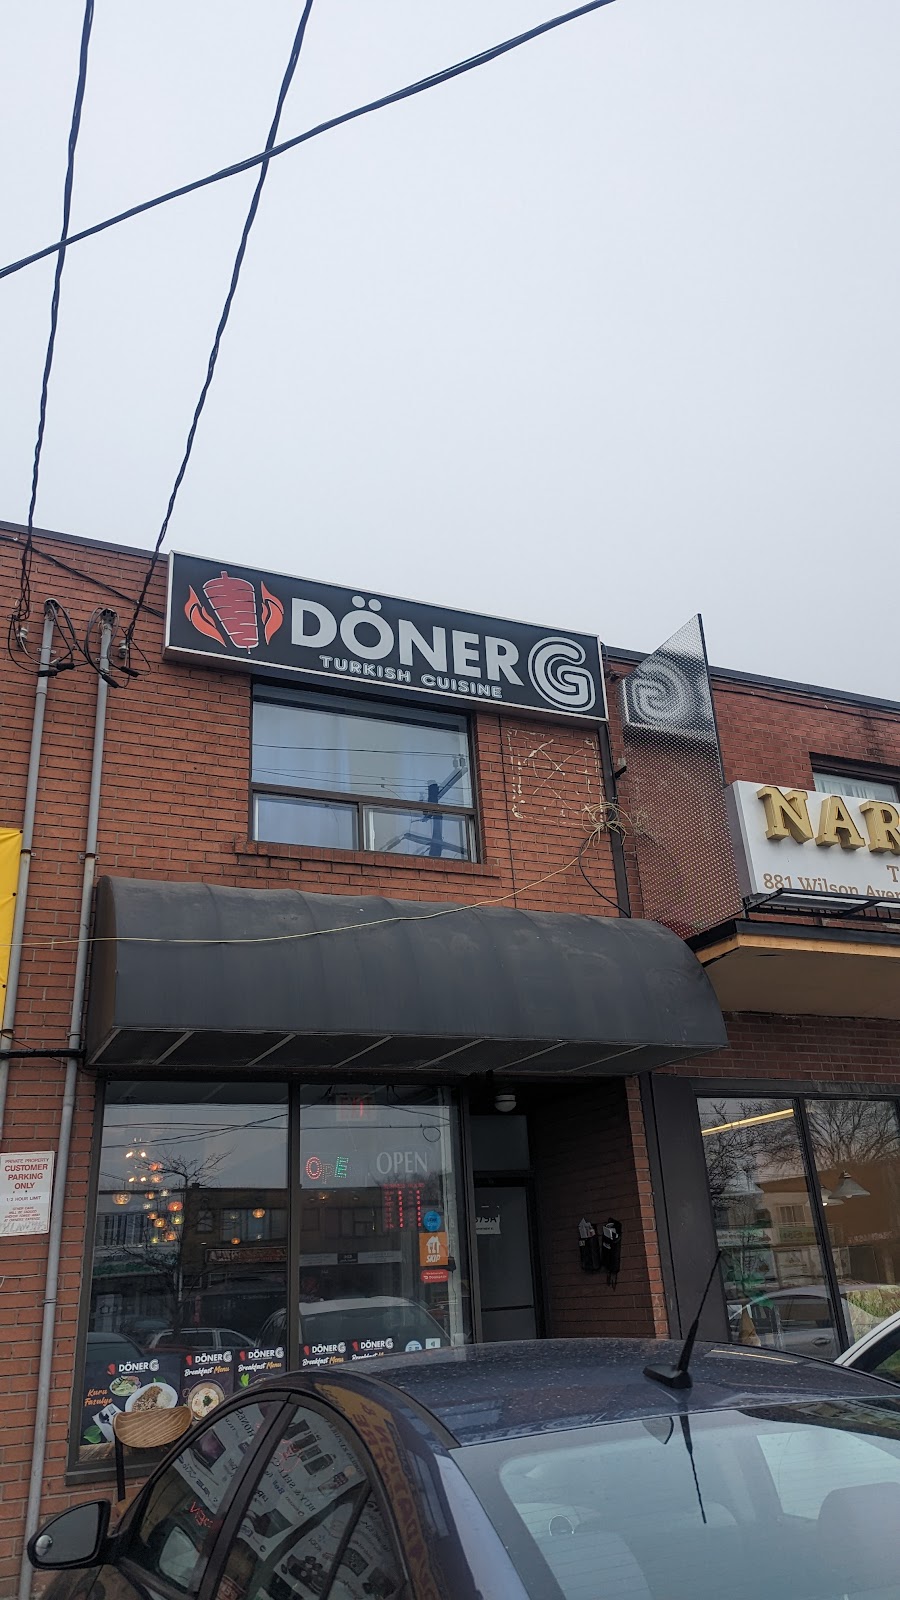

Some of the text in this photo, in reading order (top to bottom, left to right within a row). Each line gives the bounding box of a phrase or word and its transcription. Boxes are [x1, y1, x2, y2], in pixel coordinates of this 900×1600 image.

[319, 654, 503, 699] TURKISH CUISINE
[763, 872, 793, 890] 881
[797, 876, 859, 894] Wilson
[4, 1163, 49, 1172] CUSTOMER
[376, 1151, 429, 1174] OPEN
[8, 1172, 44, 1181] PARKING
[14, 1182, 36, 1190] ONLY
[426, 1254, 441, 1263] SKIP
[237, 1361, 282, 1372] Breakfast Menu
[302, 1355, 345, 1367] Breakfast Menu
[184, 1365, 230, 1377] Breakfast Menu
